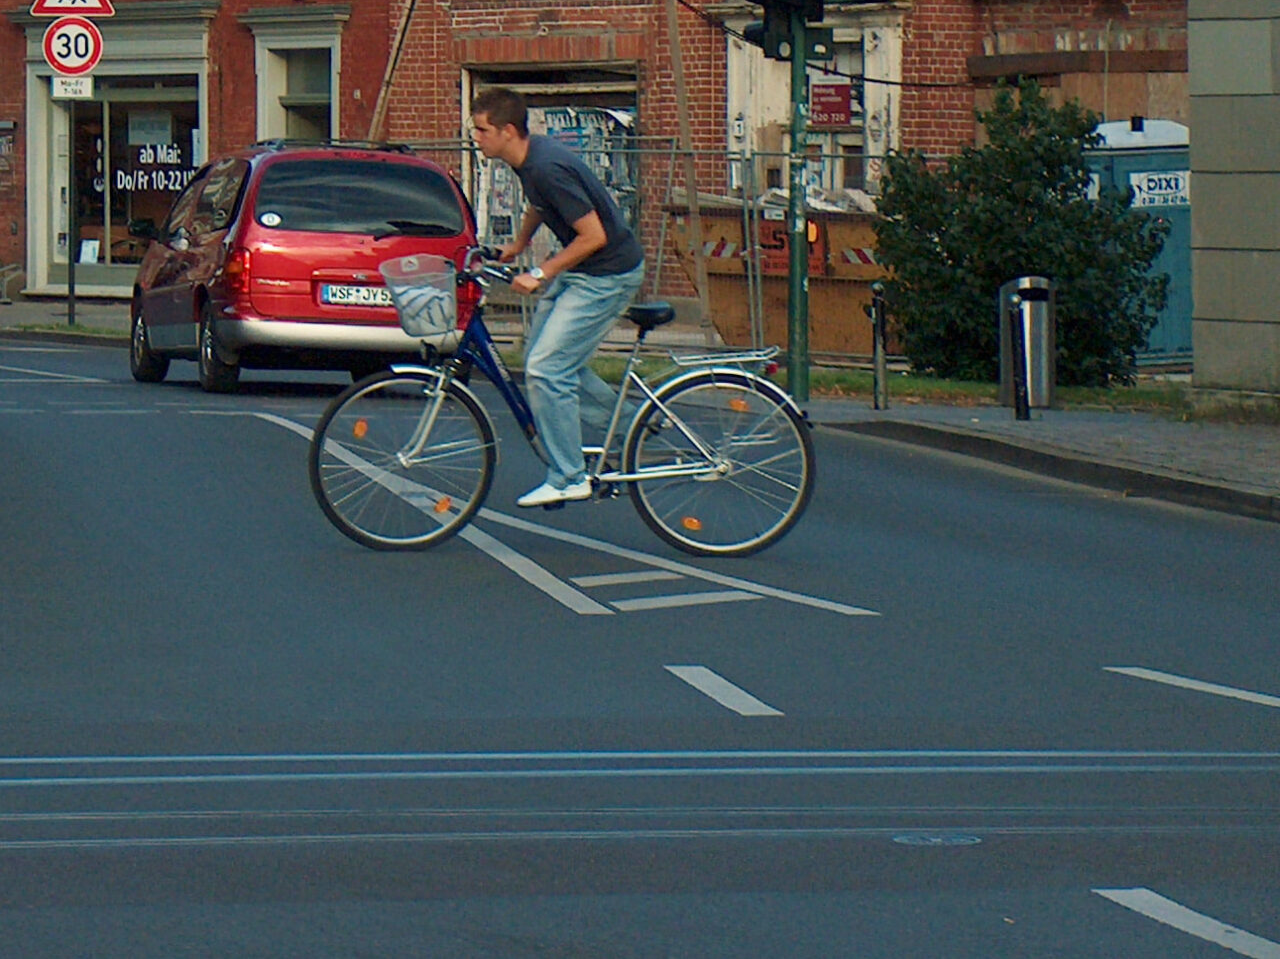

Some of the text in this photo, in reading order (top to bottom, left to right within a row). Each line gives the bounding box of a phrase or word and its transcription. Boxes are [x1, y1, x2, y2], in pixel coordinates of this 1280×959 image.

[56, 33, 90, 59] 30
[139, 143, 181, 164] ab Mai:
[117, 170, 149, 191] Do/Fr
[152, 170, 182, 191] 10-22
[330, 287, 354, 300] WSF
[363, 288, 380, 301] JY
